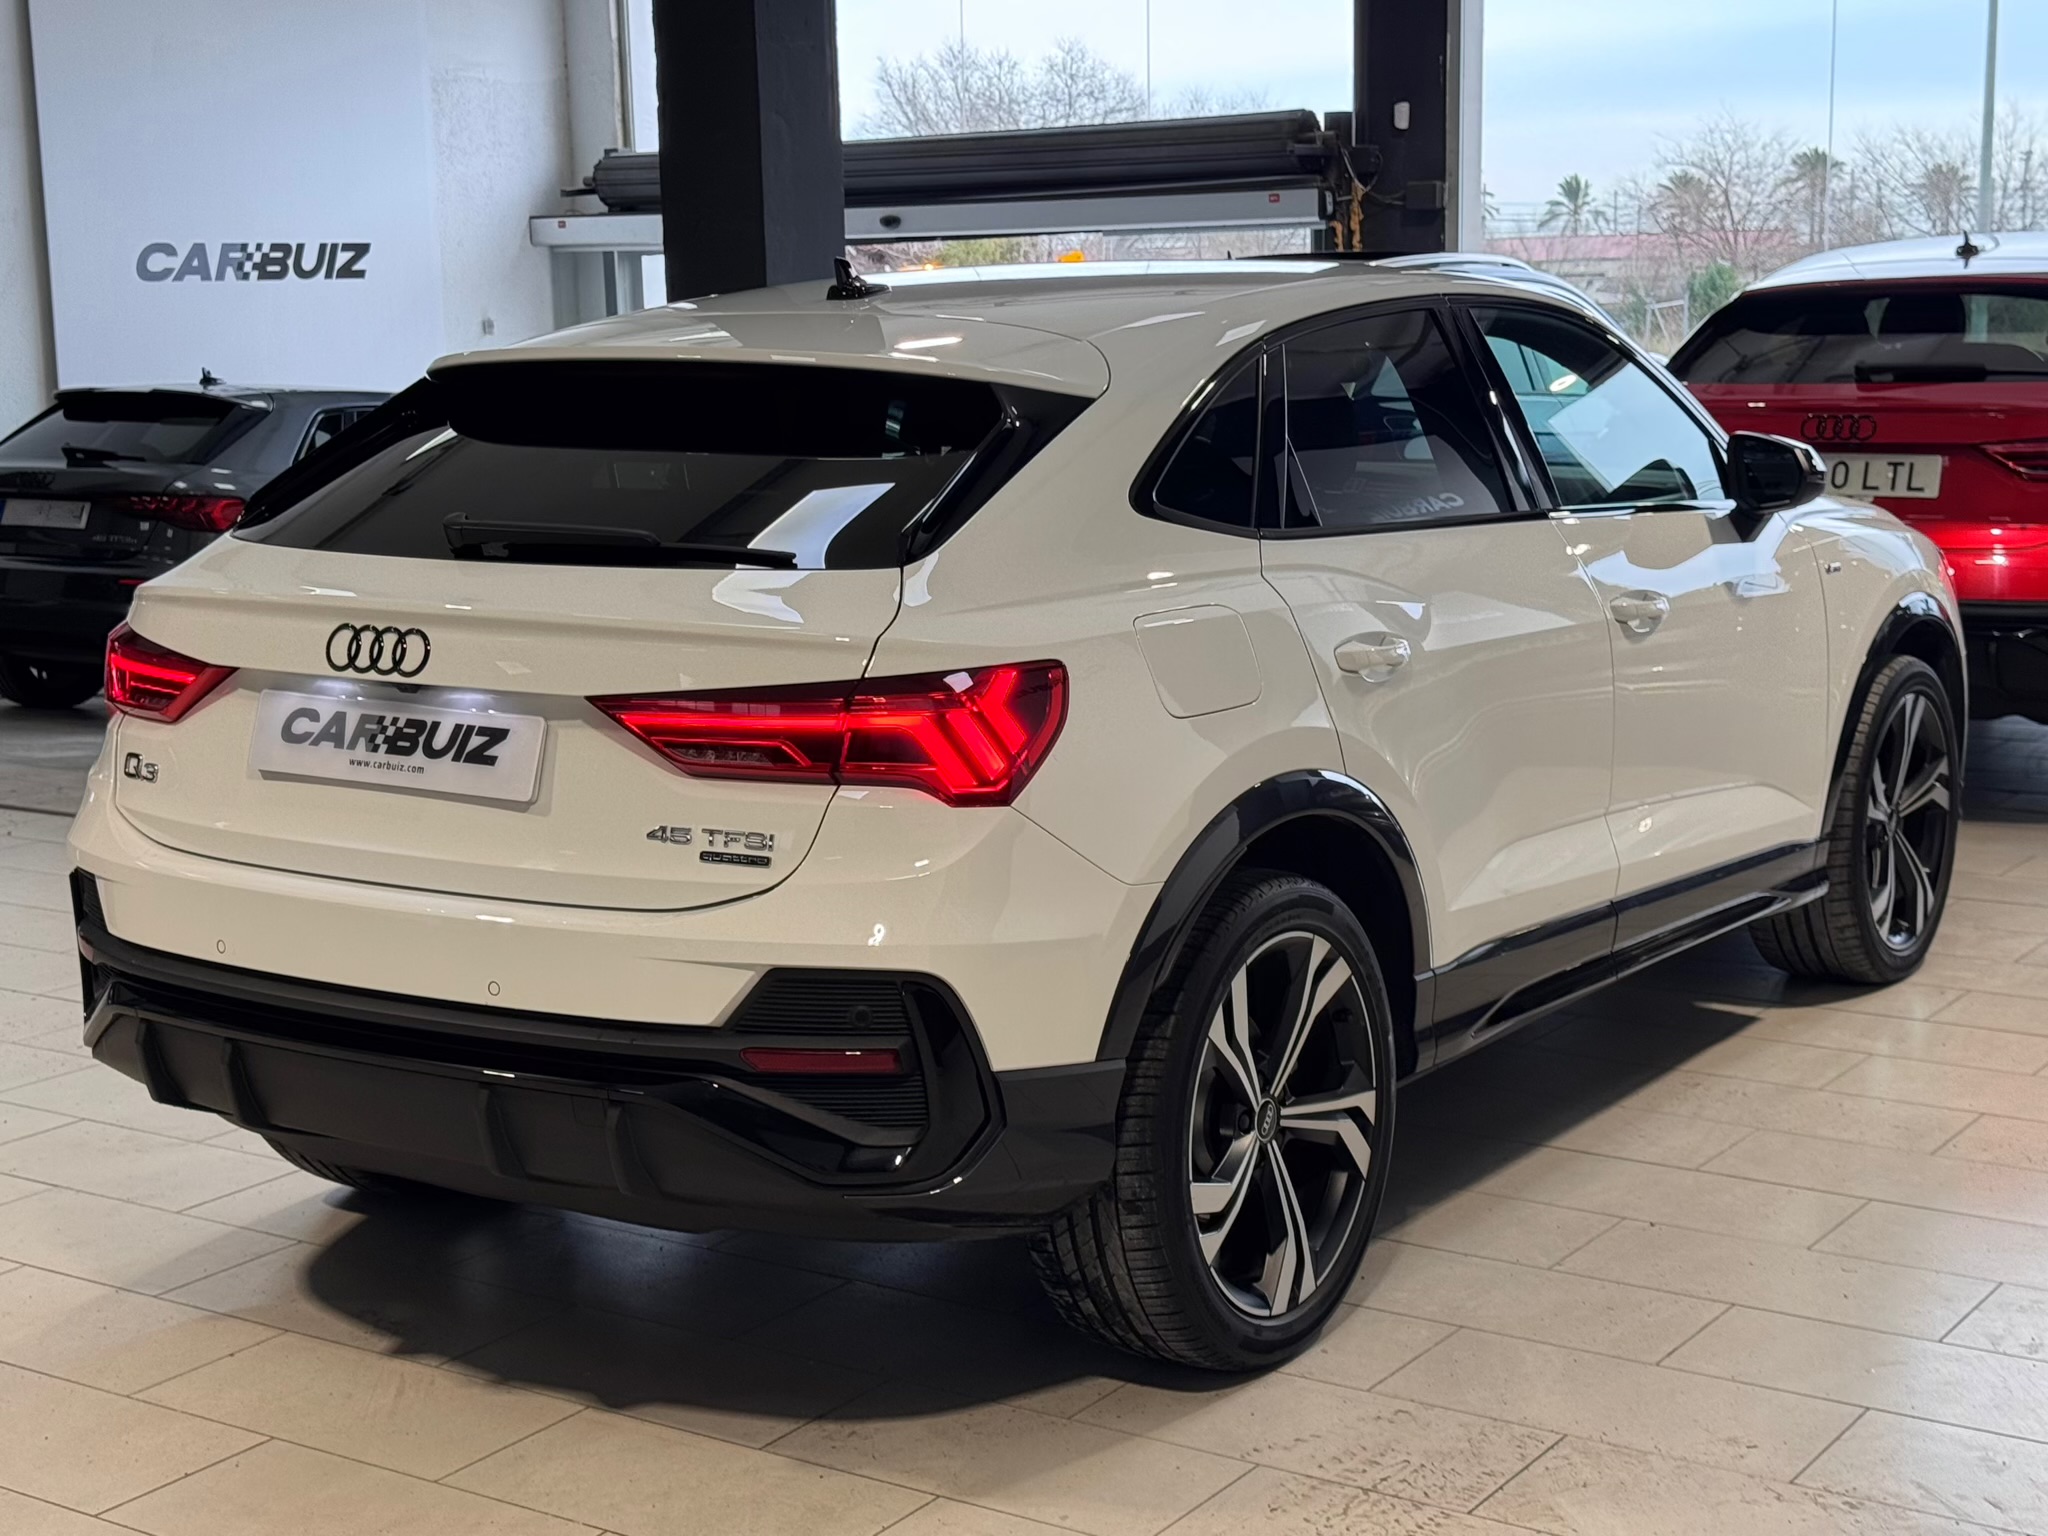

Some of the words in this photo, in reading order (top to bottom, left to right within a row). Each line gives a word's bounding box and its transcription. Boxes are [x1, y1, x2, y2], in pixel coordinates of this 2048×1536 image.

[1861, 461, 1926, 492] LTL
[123, 752, 160, 784] Q3
[348, 757, 425, 776] www.carbuiz.com
[646, 825, 693, 846] 45
[701, 827, 776, 852] TFSI
[701, 851, 770, 867] quattro
